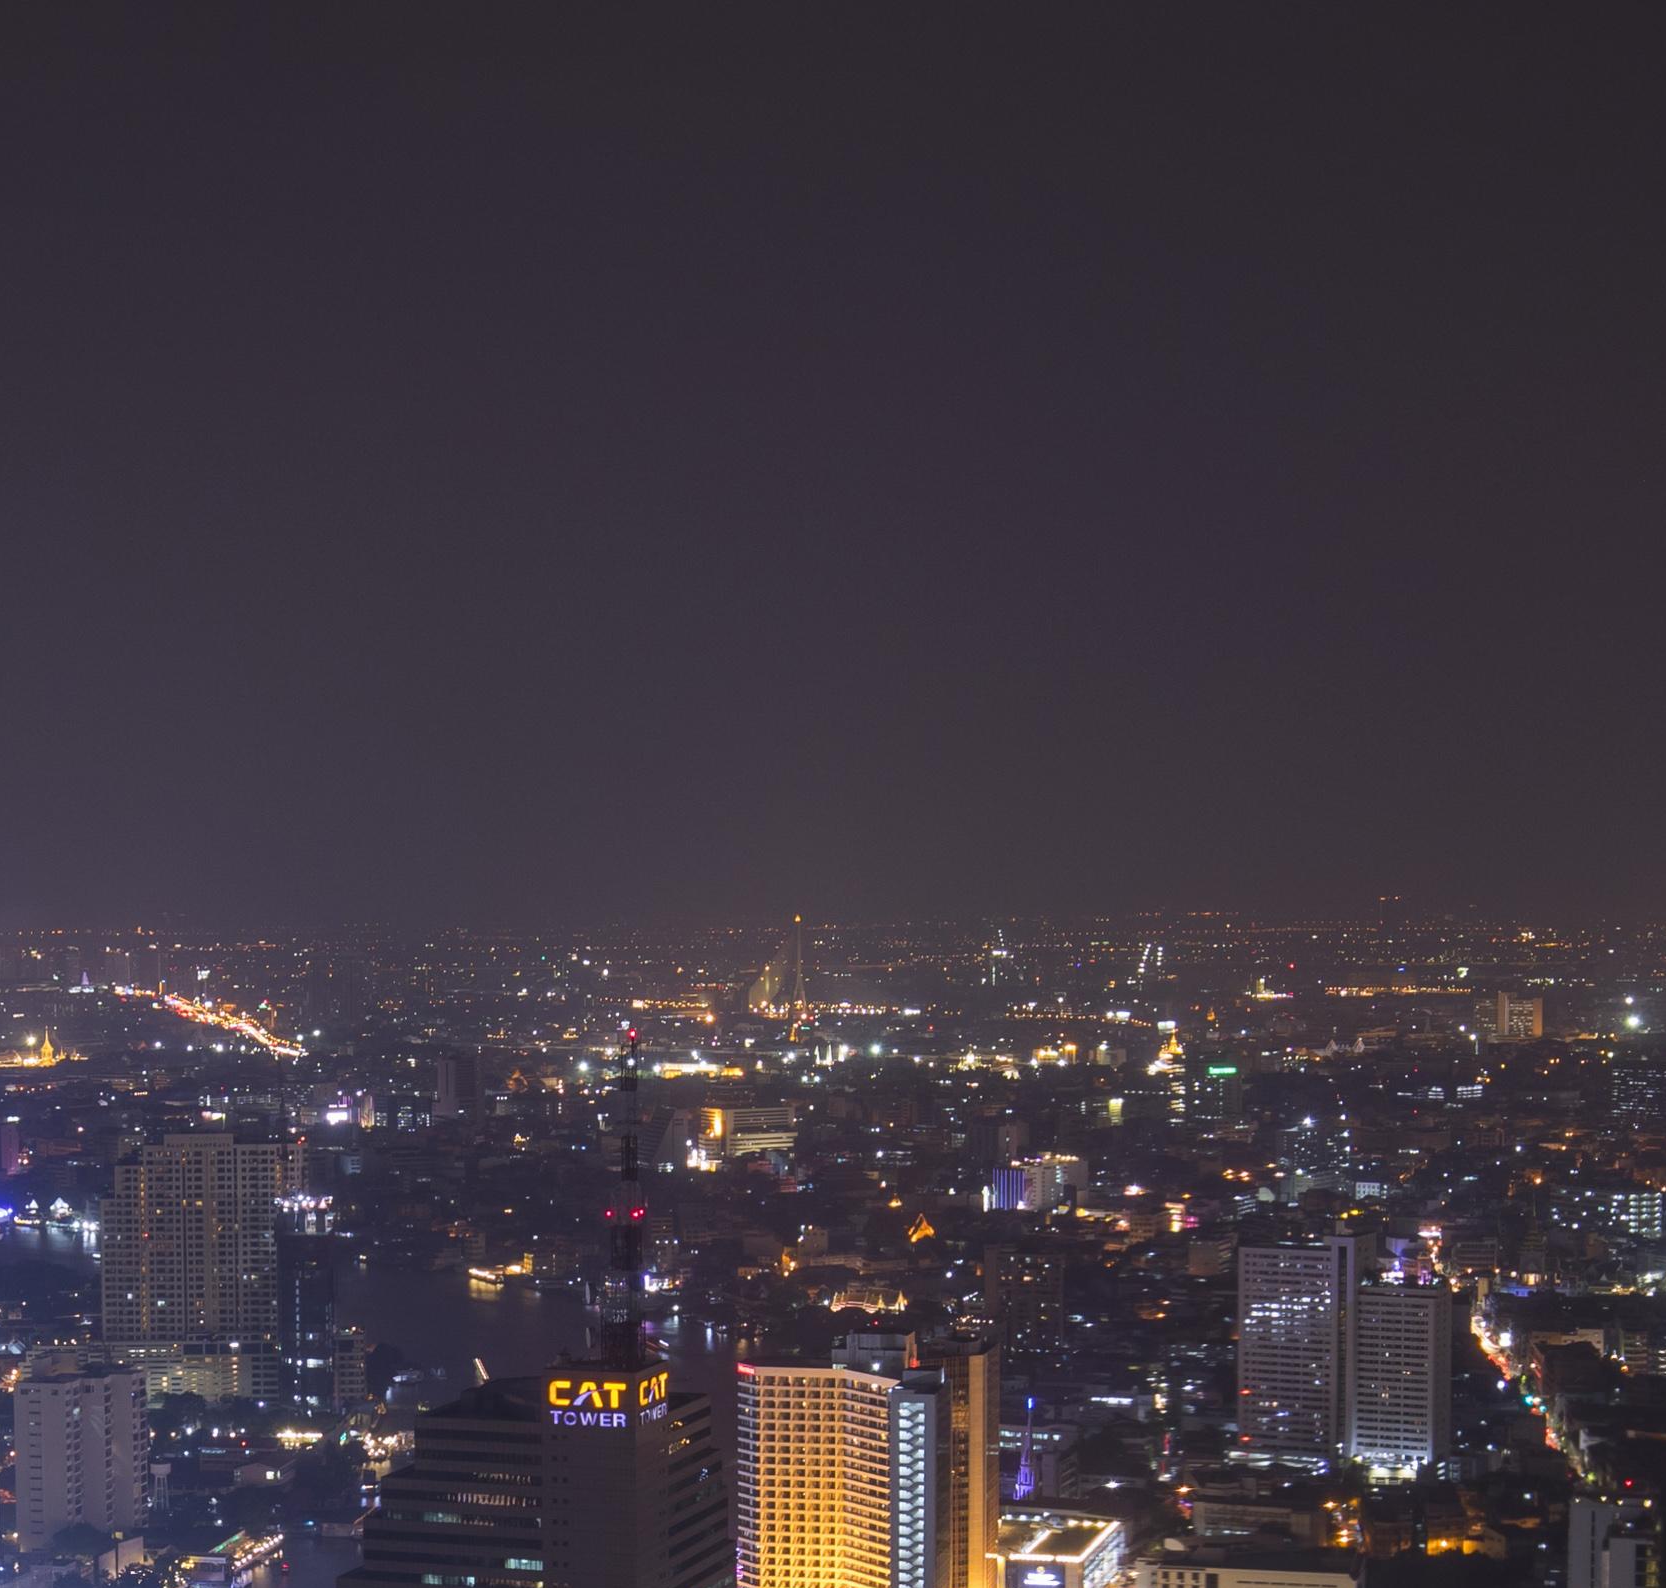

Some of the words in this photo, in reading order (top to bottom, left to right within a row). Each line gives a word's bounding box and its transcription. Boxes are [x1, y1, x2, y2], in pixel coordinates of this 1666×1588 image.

[549, 1380, 627, 1408] CAT
[639, 1372, 669, 1407] CAT
[550, 1410, 627, 1428] TOWER
[640, 1402, 668, 1425] TOWER
